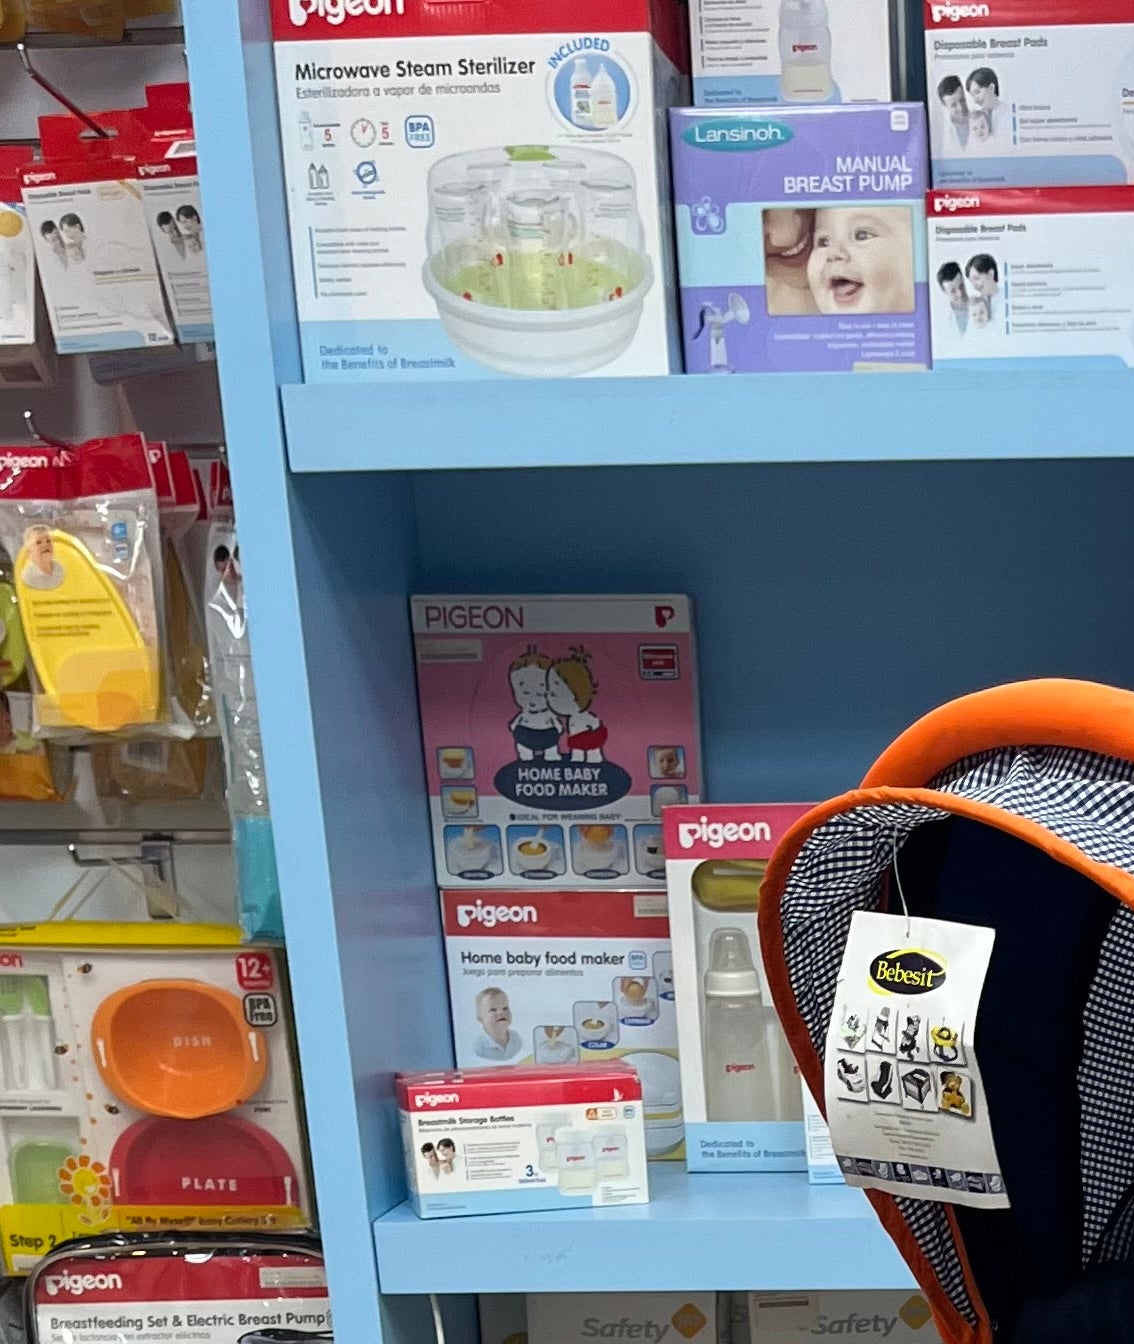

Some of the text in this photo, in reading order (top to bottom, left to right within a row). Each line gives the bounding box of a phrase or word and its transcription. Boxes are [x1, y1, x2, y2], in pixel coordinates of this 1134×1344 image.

[931, 1, 989, 23] pigeon
[547, 37, 610, 69] INCLUDED
[295, 56, 536, 81] Microwave Steam Sterilizer
[296, 82, 500, 100] Esterilizadora a vapor de microondas
[324, 129, 332, 141] 5
[381, 127, 389, 140] 5
[408, 121, 430, 132] BPA
[695, 124, 782, 142] Lansinoh
[836, 155, 913, 173] MANUAL
[783, 174, 913, 193] BREAST PUMP
[933, 193, 981, 213] pigeon
[425, 605, 524, 629] PIGEON
[518, 767, 601, 781] HOME BABY
[514, 783, 609, 796] FOOD MAKER
[678, 815, 771, 848] pigeon
[457, 900, 538, 927] pigeon
[238, 957, 271, 979] 12+
[461, 951, 626, 967] Home baby food maker
[877, 961, 934, 988] Bebesit
[173, 1035, 212, 1048] DISH
[415, 1091, 460, 1107] pigeon
[525, 1164, 534, 1177] 3
[182, 1176, 239, 1191] PLATE
[10, 1234, 43, 1249] Step
[45, 1269, 122, 1296] pigeon
[50, 1312, 325, 1331] Breastfeeding Set & Electric Breast Pump
[582, 1317, 671, 1344] Safety
[811, 1313, 899, 1337] Safety
